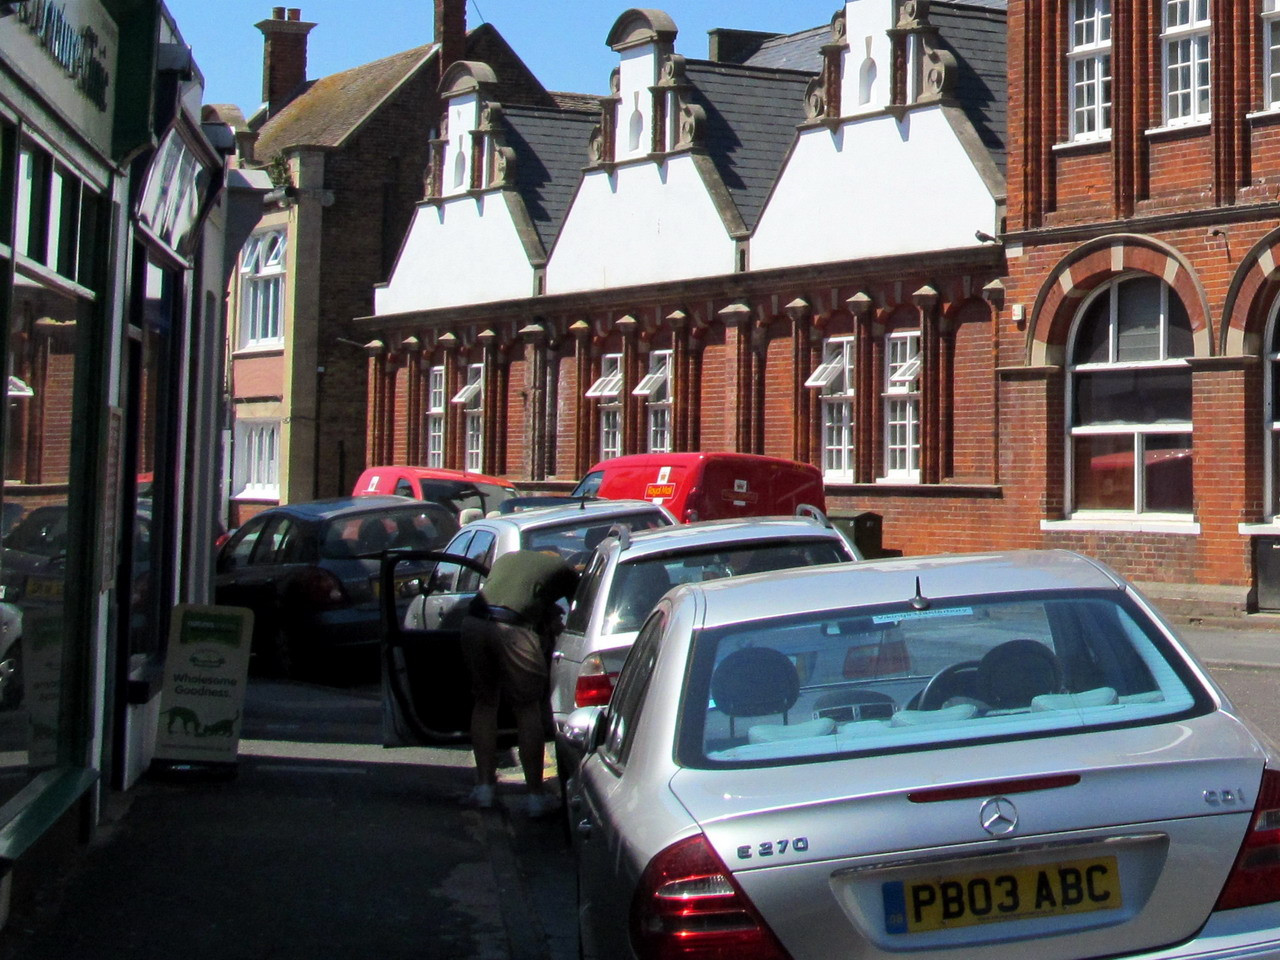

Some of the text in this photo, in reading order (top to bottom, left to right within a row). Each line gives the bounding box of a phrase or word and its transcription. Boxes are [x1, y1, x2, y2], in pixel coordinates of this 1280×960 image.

[173, 672, 238, 688] Wholesome
[174, 683, 232, 699] Goodness.
[737, 837, 809, 859] E 270
[910, 864, 1111, 923] PB03 ABC
